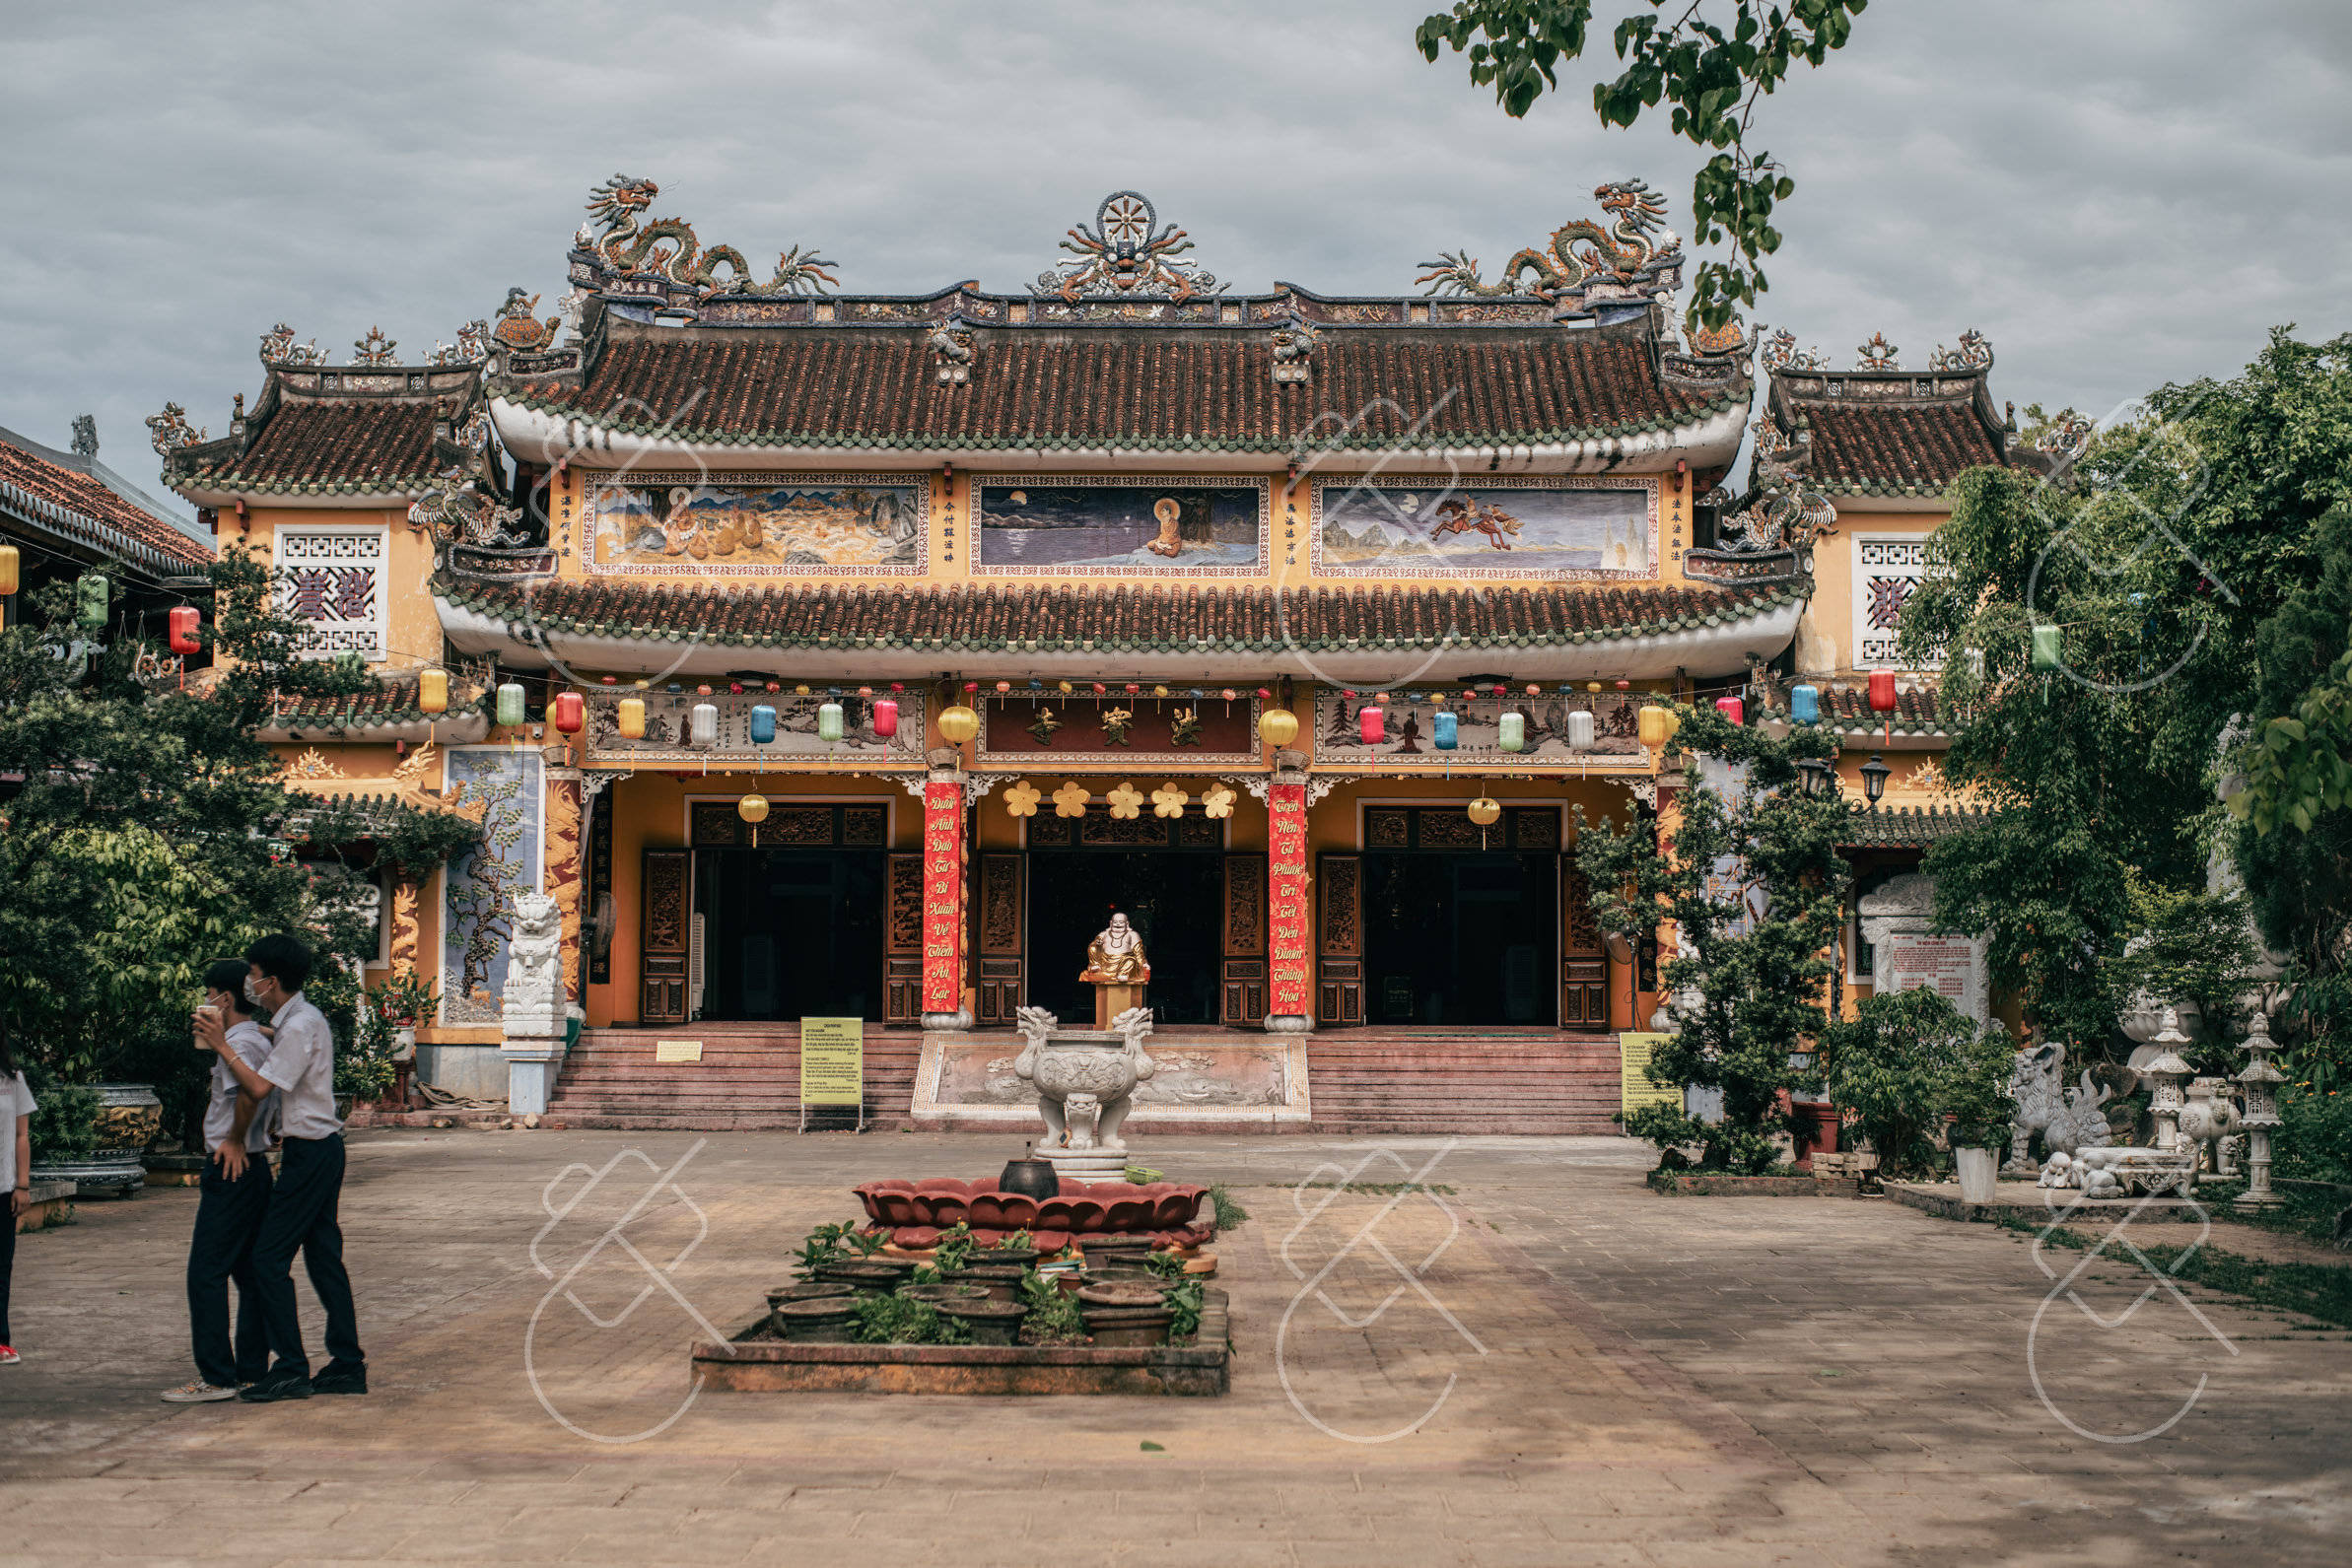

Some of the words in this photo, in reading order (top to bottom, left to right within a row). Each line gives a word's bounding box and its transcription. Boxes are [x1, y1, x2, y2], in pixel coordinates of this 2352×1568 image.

[1276, 799, 1299, 813] Trên
[935, 881, 949, 895] Bi
[1280, 883, 1298, 897] Trí
[929, 902, 954, 916] Xuân
[928, 943, 954, 958] Thêm
[932, 966, 949, 979] An
[930, 987, 950, 1002] Lạc
[1278, 989, 1299, 1003] Hoa
